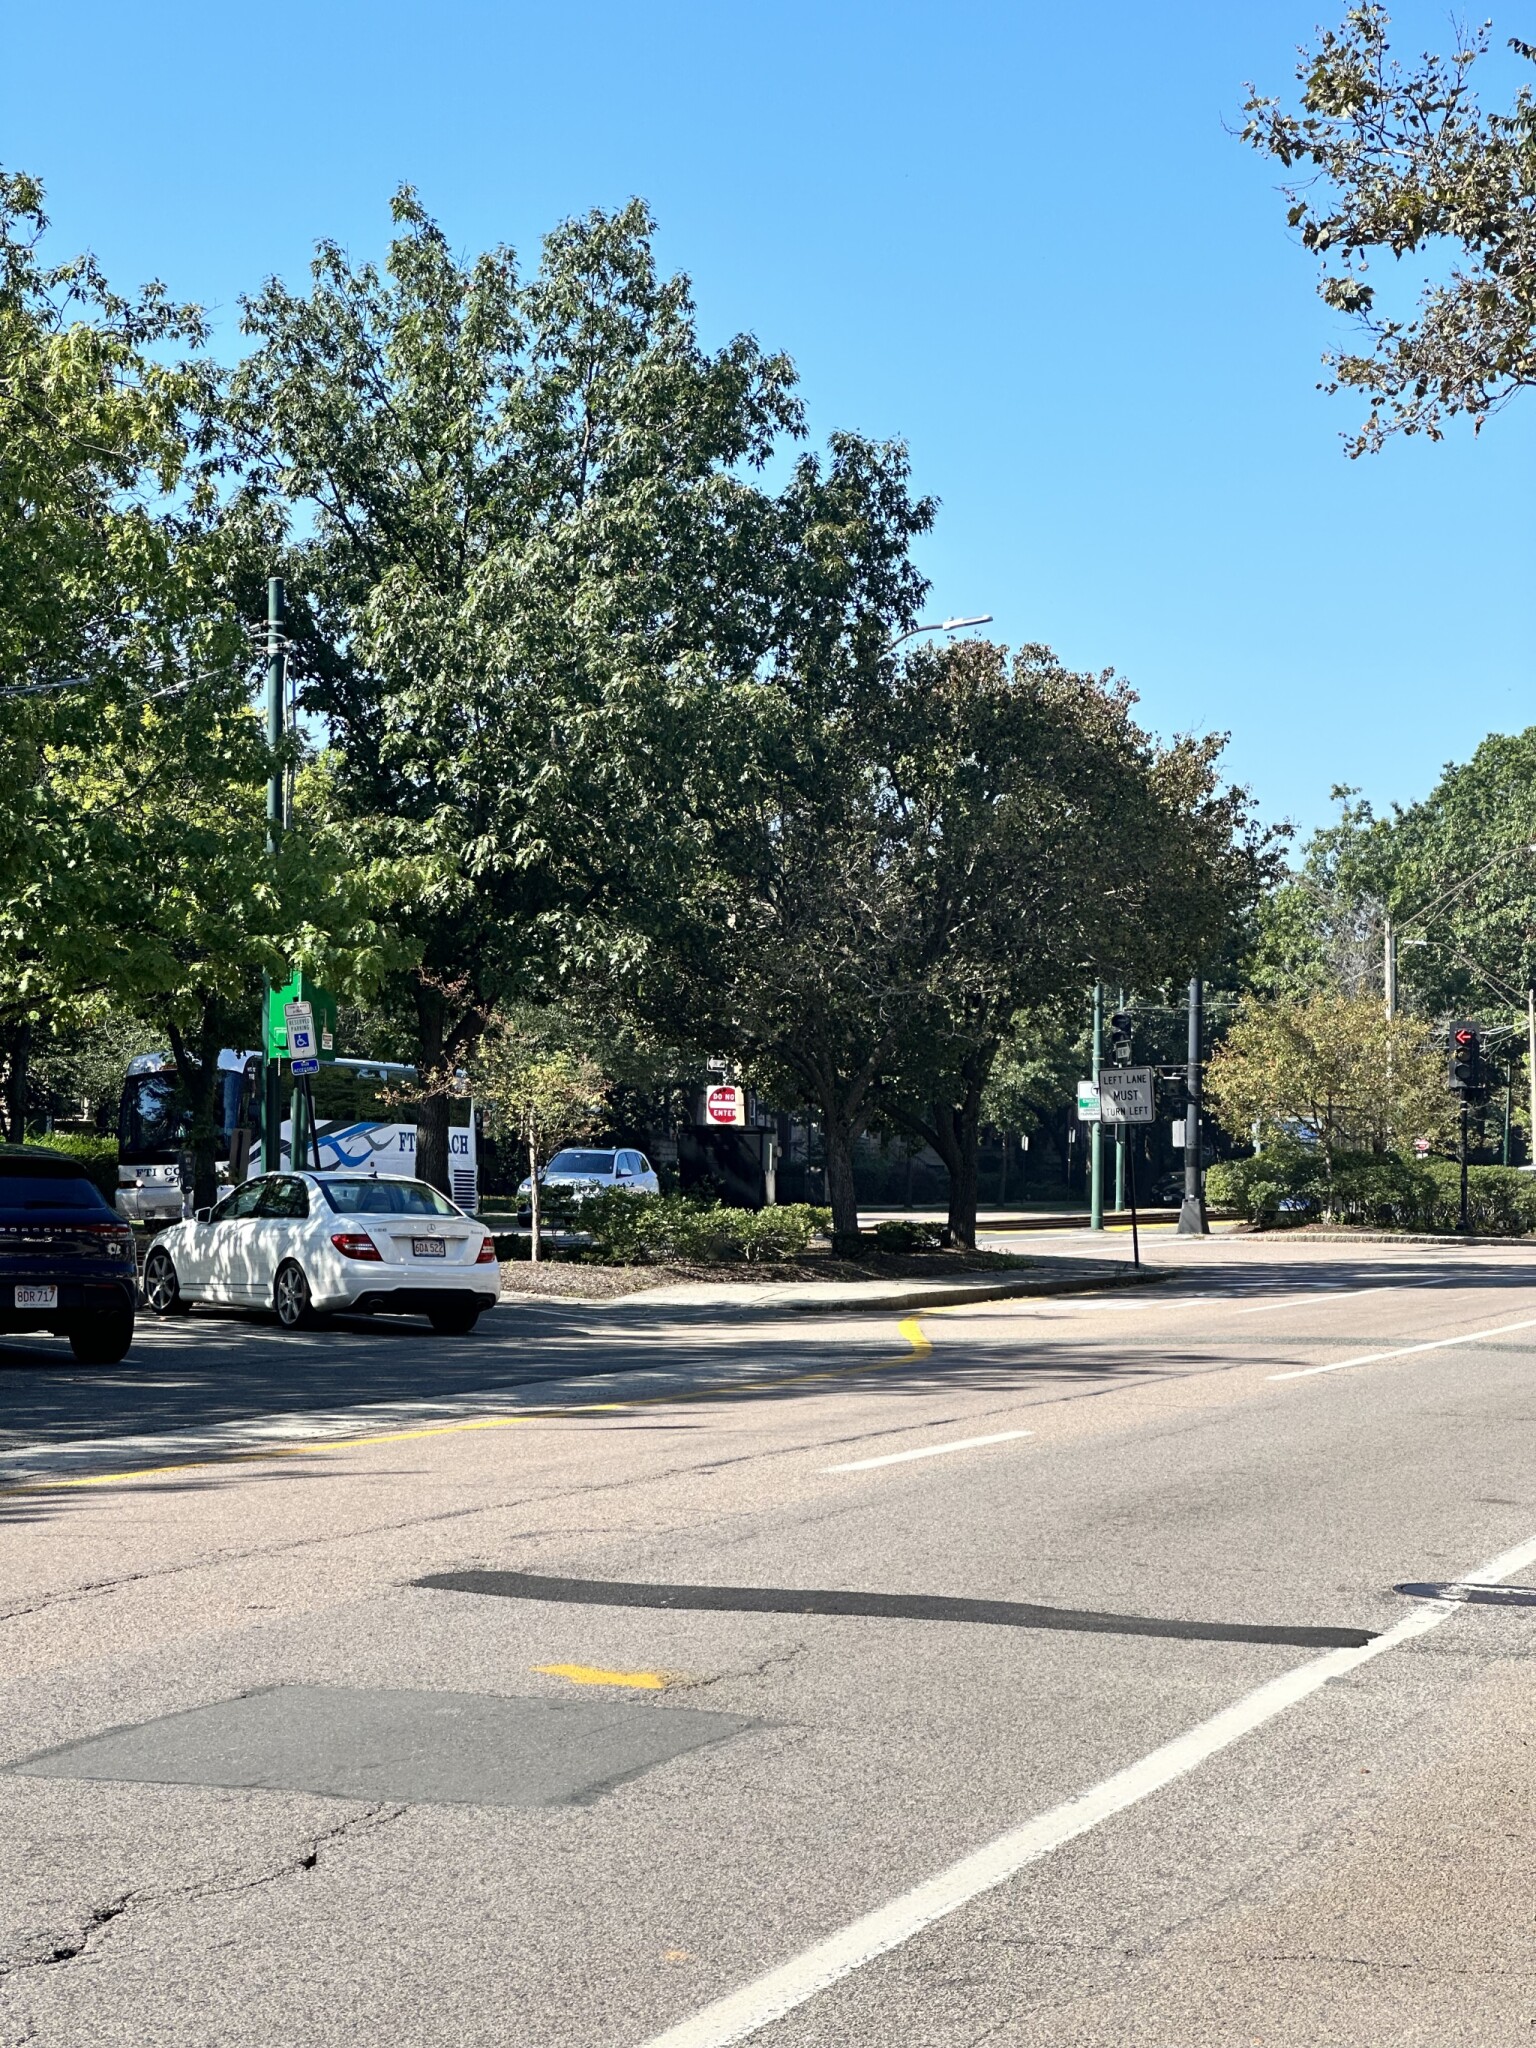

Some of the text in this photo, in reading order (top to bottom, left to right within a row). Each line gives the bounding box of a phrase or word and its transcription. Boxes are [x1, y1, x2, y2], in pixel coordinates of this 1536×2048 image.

[1103, 1074, 1147, 1085] LEFT LANE
[1114, 1090, 1138, 1100] MUST
[1106, 1107, 1125, 1116] TURN
[1129, 1106, 1148, 1116] LEFT
[135, 1168, 157, 1178] FTI
[17, 1290, 55, 1302] 8DR 717
